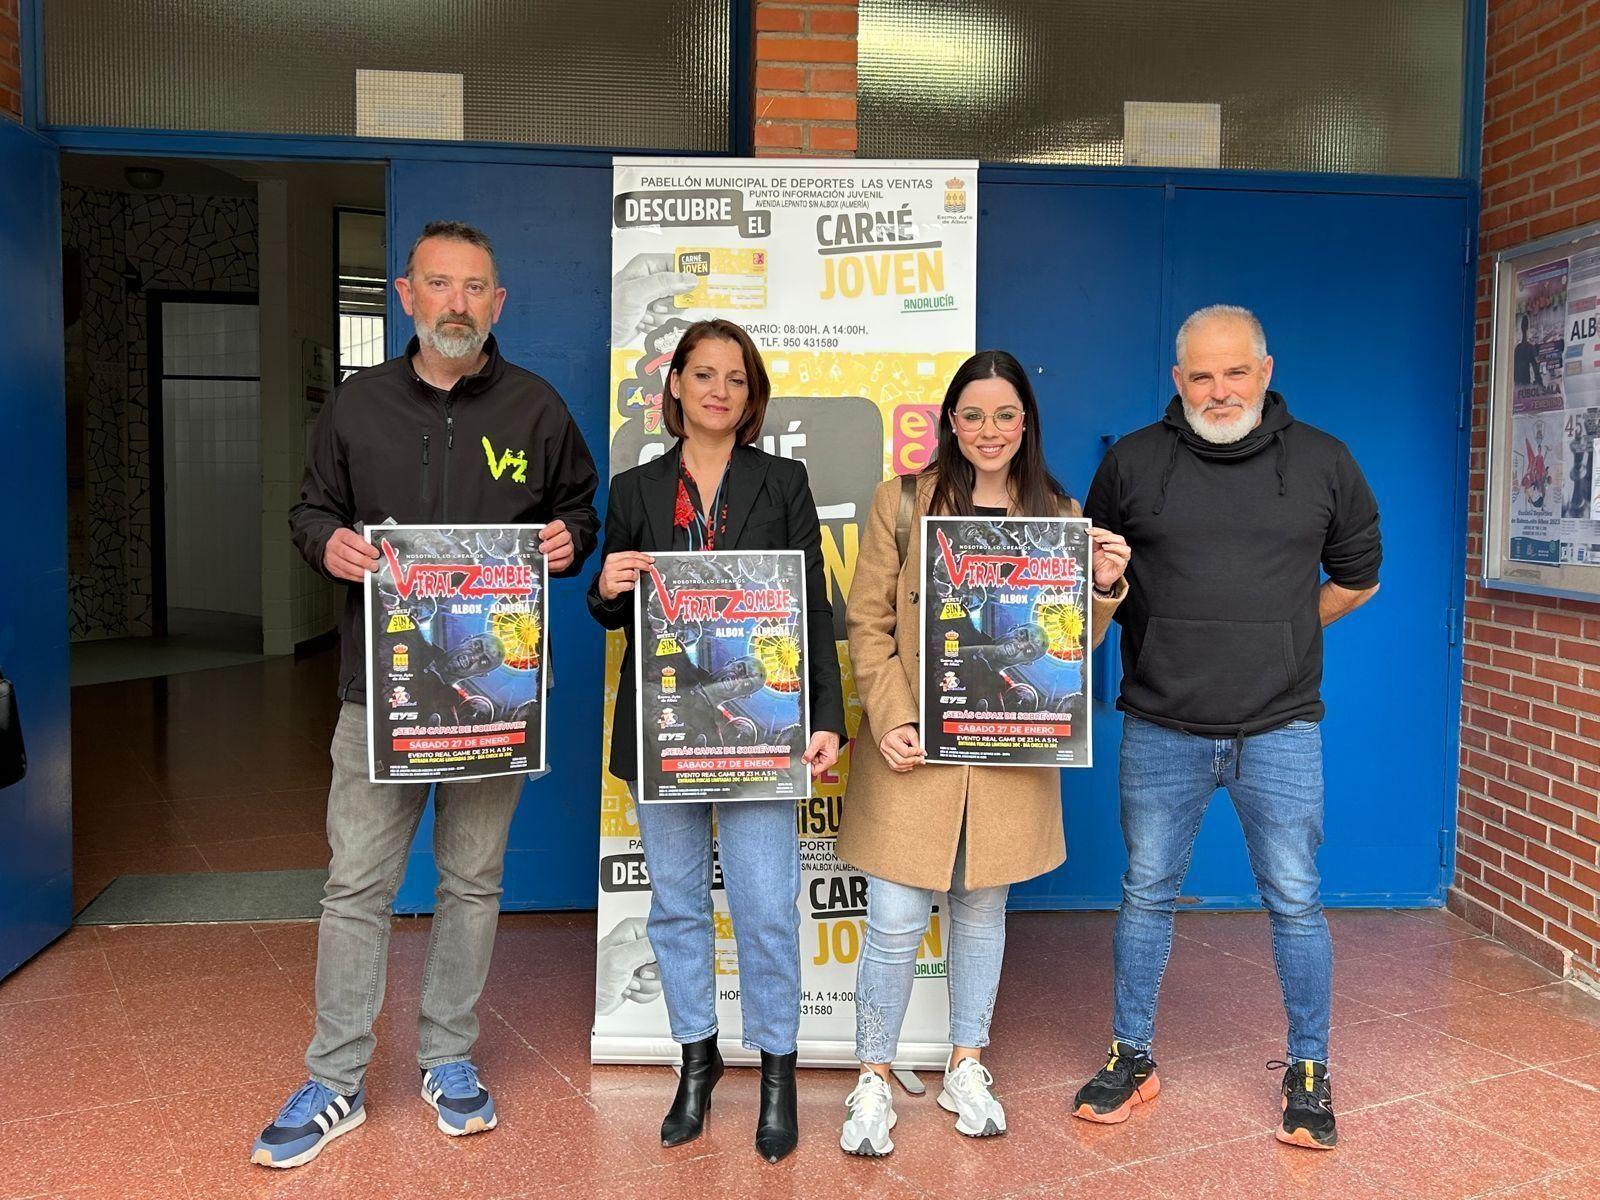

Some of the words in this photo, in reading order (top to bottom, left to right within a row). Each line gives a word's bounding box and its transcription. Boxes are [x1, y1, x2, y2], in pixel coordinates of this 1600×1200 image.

[641, 176, 701, 188] PABELLÓN
[706, 178, 768, 188] MUNICIPAL
[772, 179, 787, 188] DE
[791, 179, 854, 189] DEPORTES
[861, 179, 883, 189] LAS
[887, 179, 933, 189] VENTAS
[749, 190, 779, 198] PUNTO
[782, 189, 844, 198] INFORMACIÓN
[847, 190, 884, 199] JUVENIL
[782, 200, 807, 208] LEPANTO
[820, 200, 839, 208] ALBOX
[840, 200, 870, 209] (ALMERÍA)
[625, 198, 731, 222] DESCUBRE
[748, 216, 765, 234] EL
[816, 203, 914, 247] CARNÉ
[682, 263, 708, 273] JOVEN
[819, 250, 945, 300] JOVEN
[903, 295, 954, 310] ANDALUCÍA
[739, 325, 781, 334] ORARIO:
[783, 325, 820, 334] 08:00H.
[822, 325, 830, 334] A
[833, 325, 869, 335] 14:00H.
[760, 338, 780, 347] TLF.
[783, 338, 801, 347] 950
[803, 338, 838, 348] 431580
[936, 528, 1006, 589] VIRAL
[1006, 555, 1076, 590] ZOMBIE
[381, 538, 458, 600] VIRAL
[458, 564, 533, 600] ZOMBIE
[650, 564, 721, 625] VIRAL
[721, 589, 791, 623] ZOMBIE
[999, 593, 1028, 604] ALBOX
[451, 603, 482, 615] ALBOX
[715, 627, 745, 638] ALBOX
[975, 711, 1004, 720] CAPAZ
[1004, 711, 1017, 720] DE
[427, 726, 459, 735] CAPAZ
[459, 725, 471, 734] DE
[958, 723, 995, 733] SÁBADO
[1024, 726, 1055, 734] ENERO
[409, 740, 449, 749] SÁBADO
[451, 740, 462, 748] 27
[464, 739, 477, 747] DE
[480, 736, 510, 746] ENERO
[694, 746, 723, 755] CAPAZ
[724, 746, 736, 754] DE
[677, 760, 714, 769] SÁBADO
[729, 760, 742, 768] DE
[812, 863, 833, 871] ALBOX
[809, 876, 868, 911] CAR
[914, 961, 947, 976] DALUCÍ
[816, 992, 824, 1001] A
[827, 992, 857, 1001] 14:00
